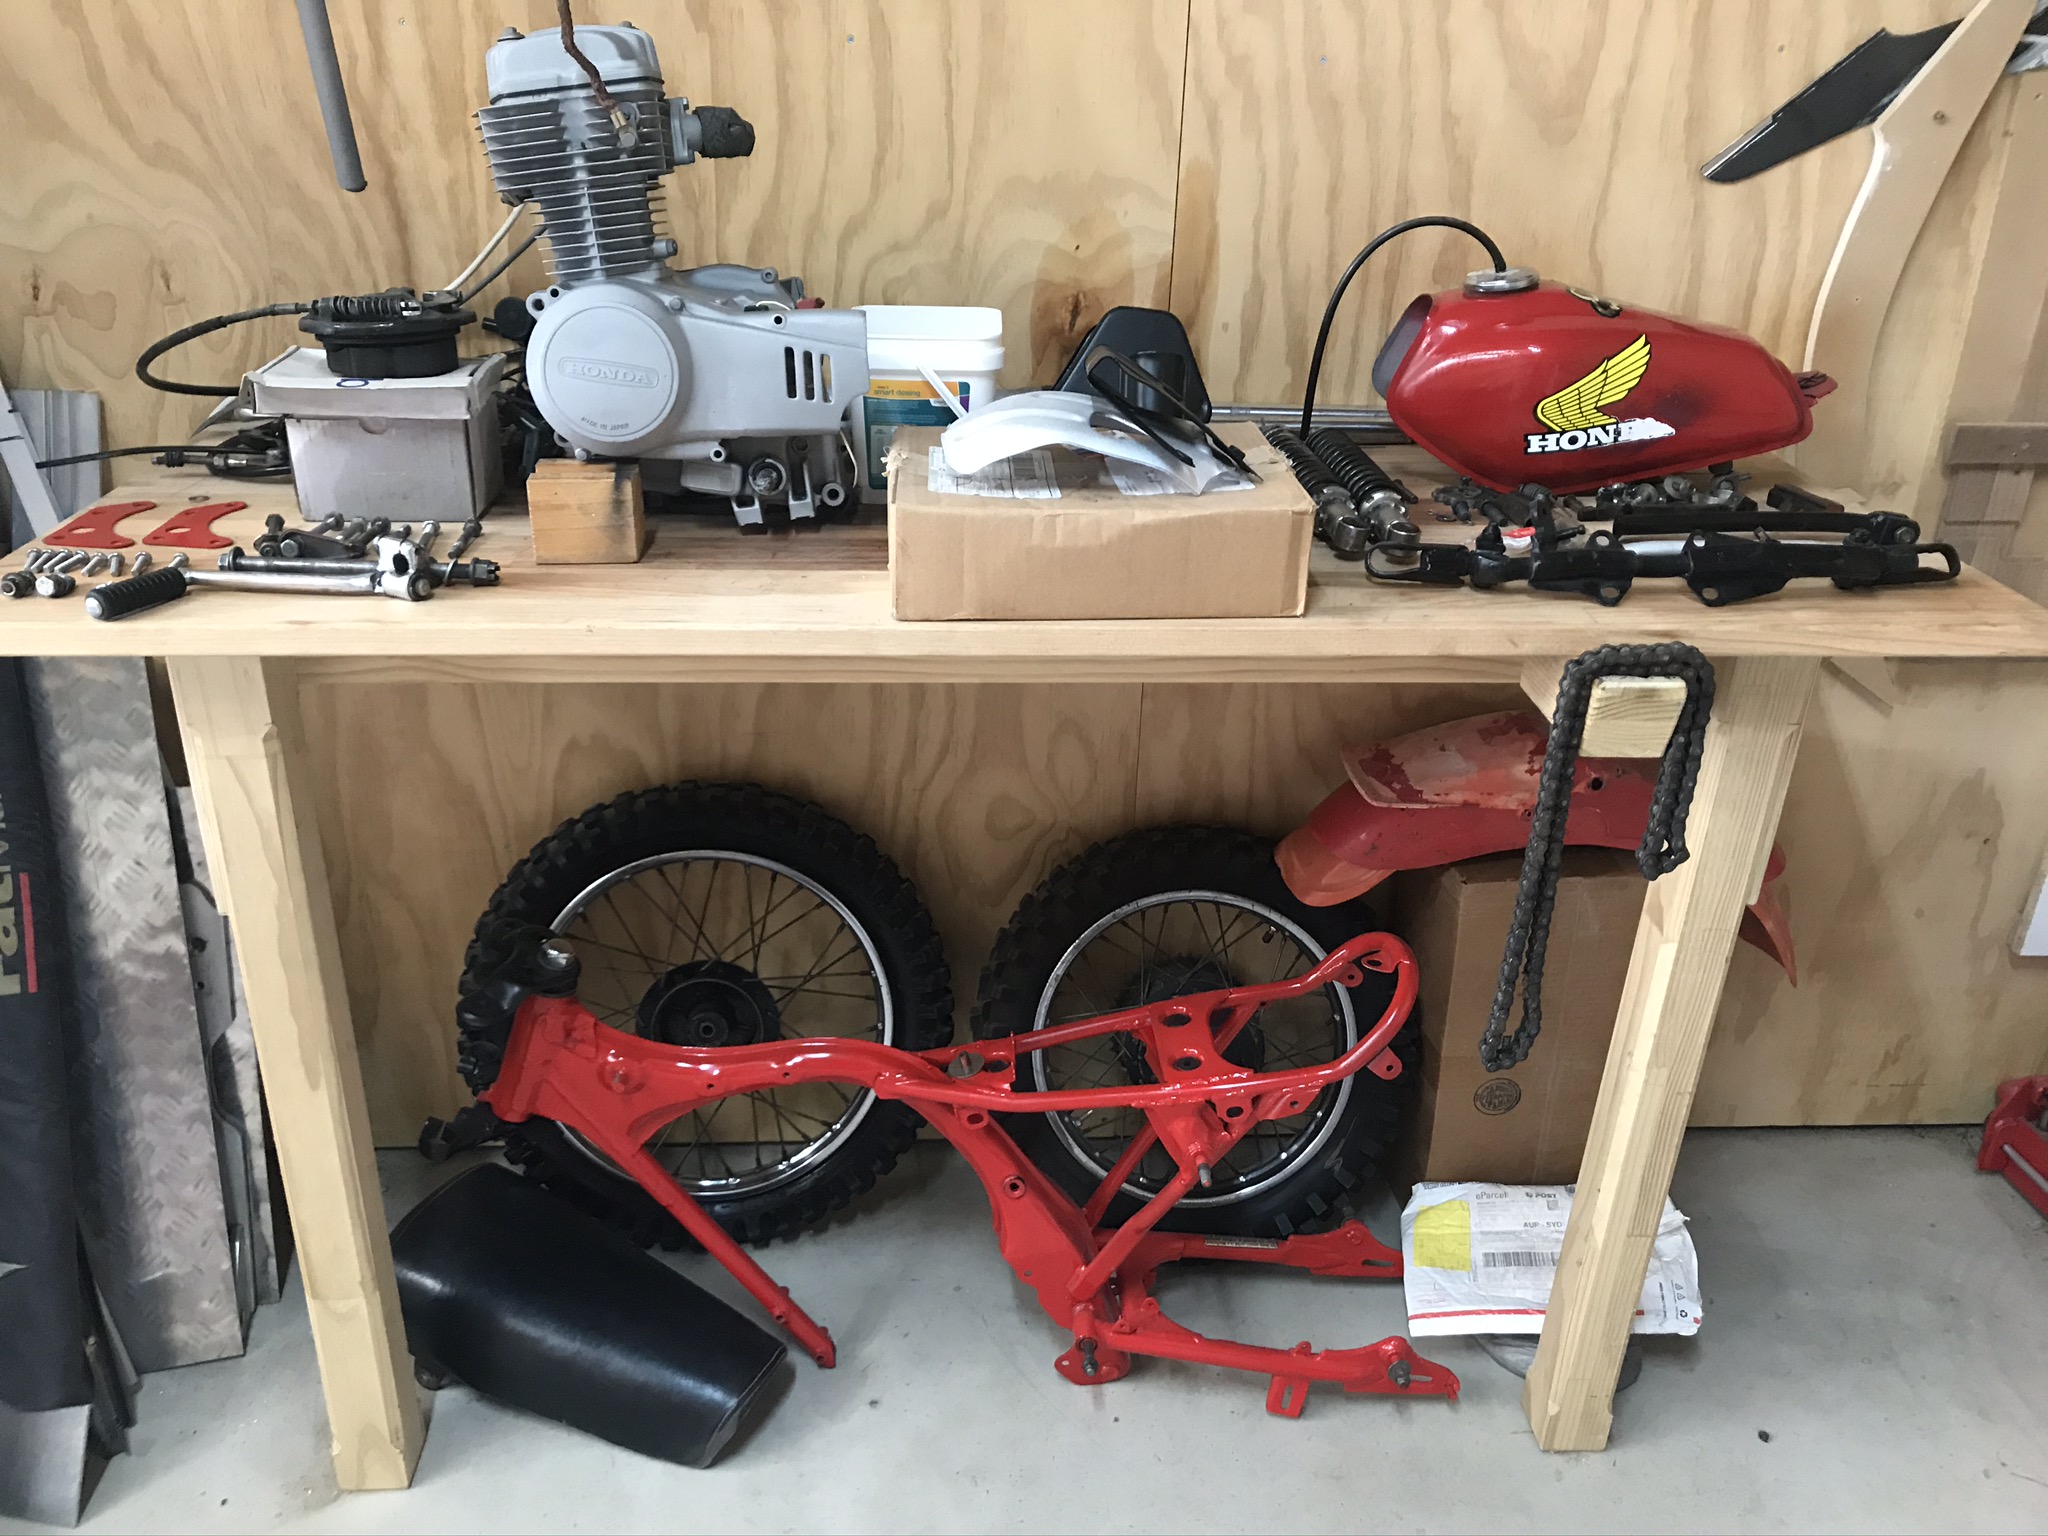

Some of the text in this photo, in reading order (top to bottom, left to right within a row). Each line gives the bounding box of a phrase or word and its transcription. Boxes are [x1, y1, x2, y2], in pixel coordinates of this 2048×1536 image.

[567, 364, 653, 385] HONDA
[1475, 1190, 1507, 1200] eParcel
[1535, 1192, 1558, 1200] POST
